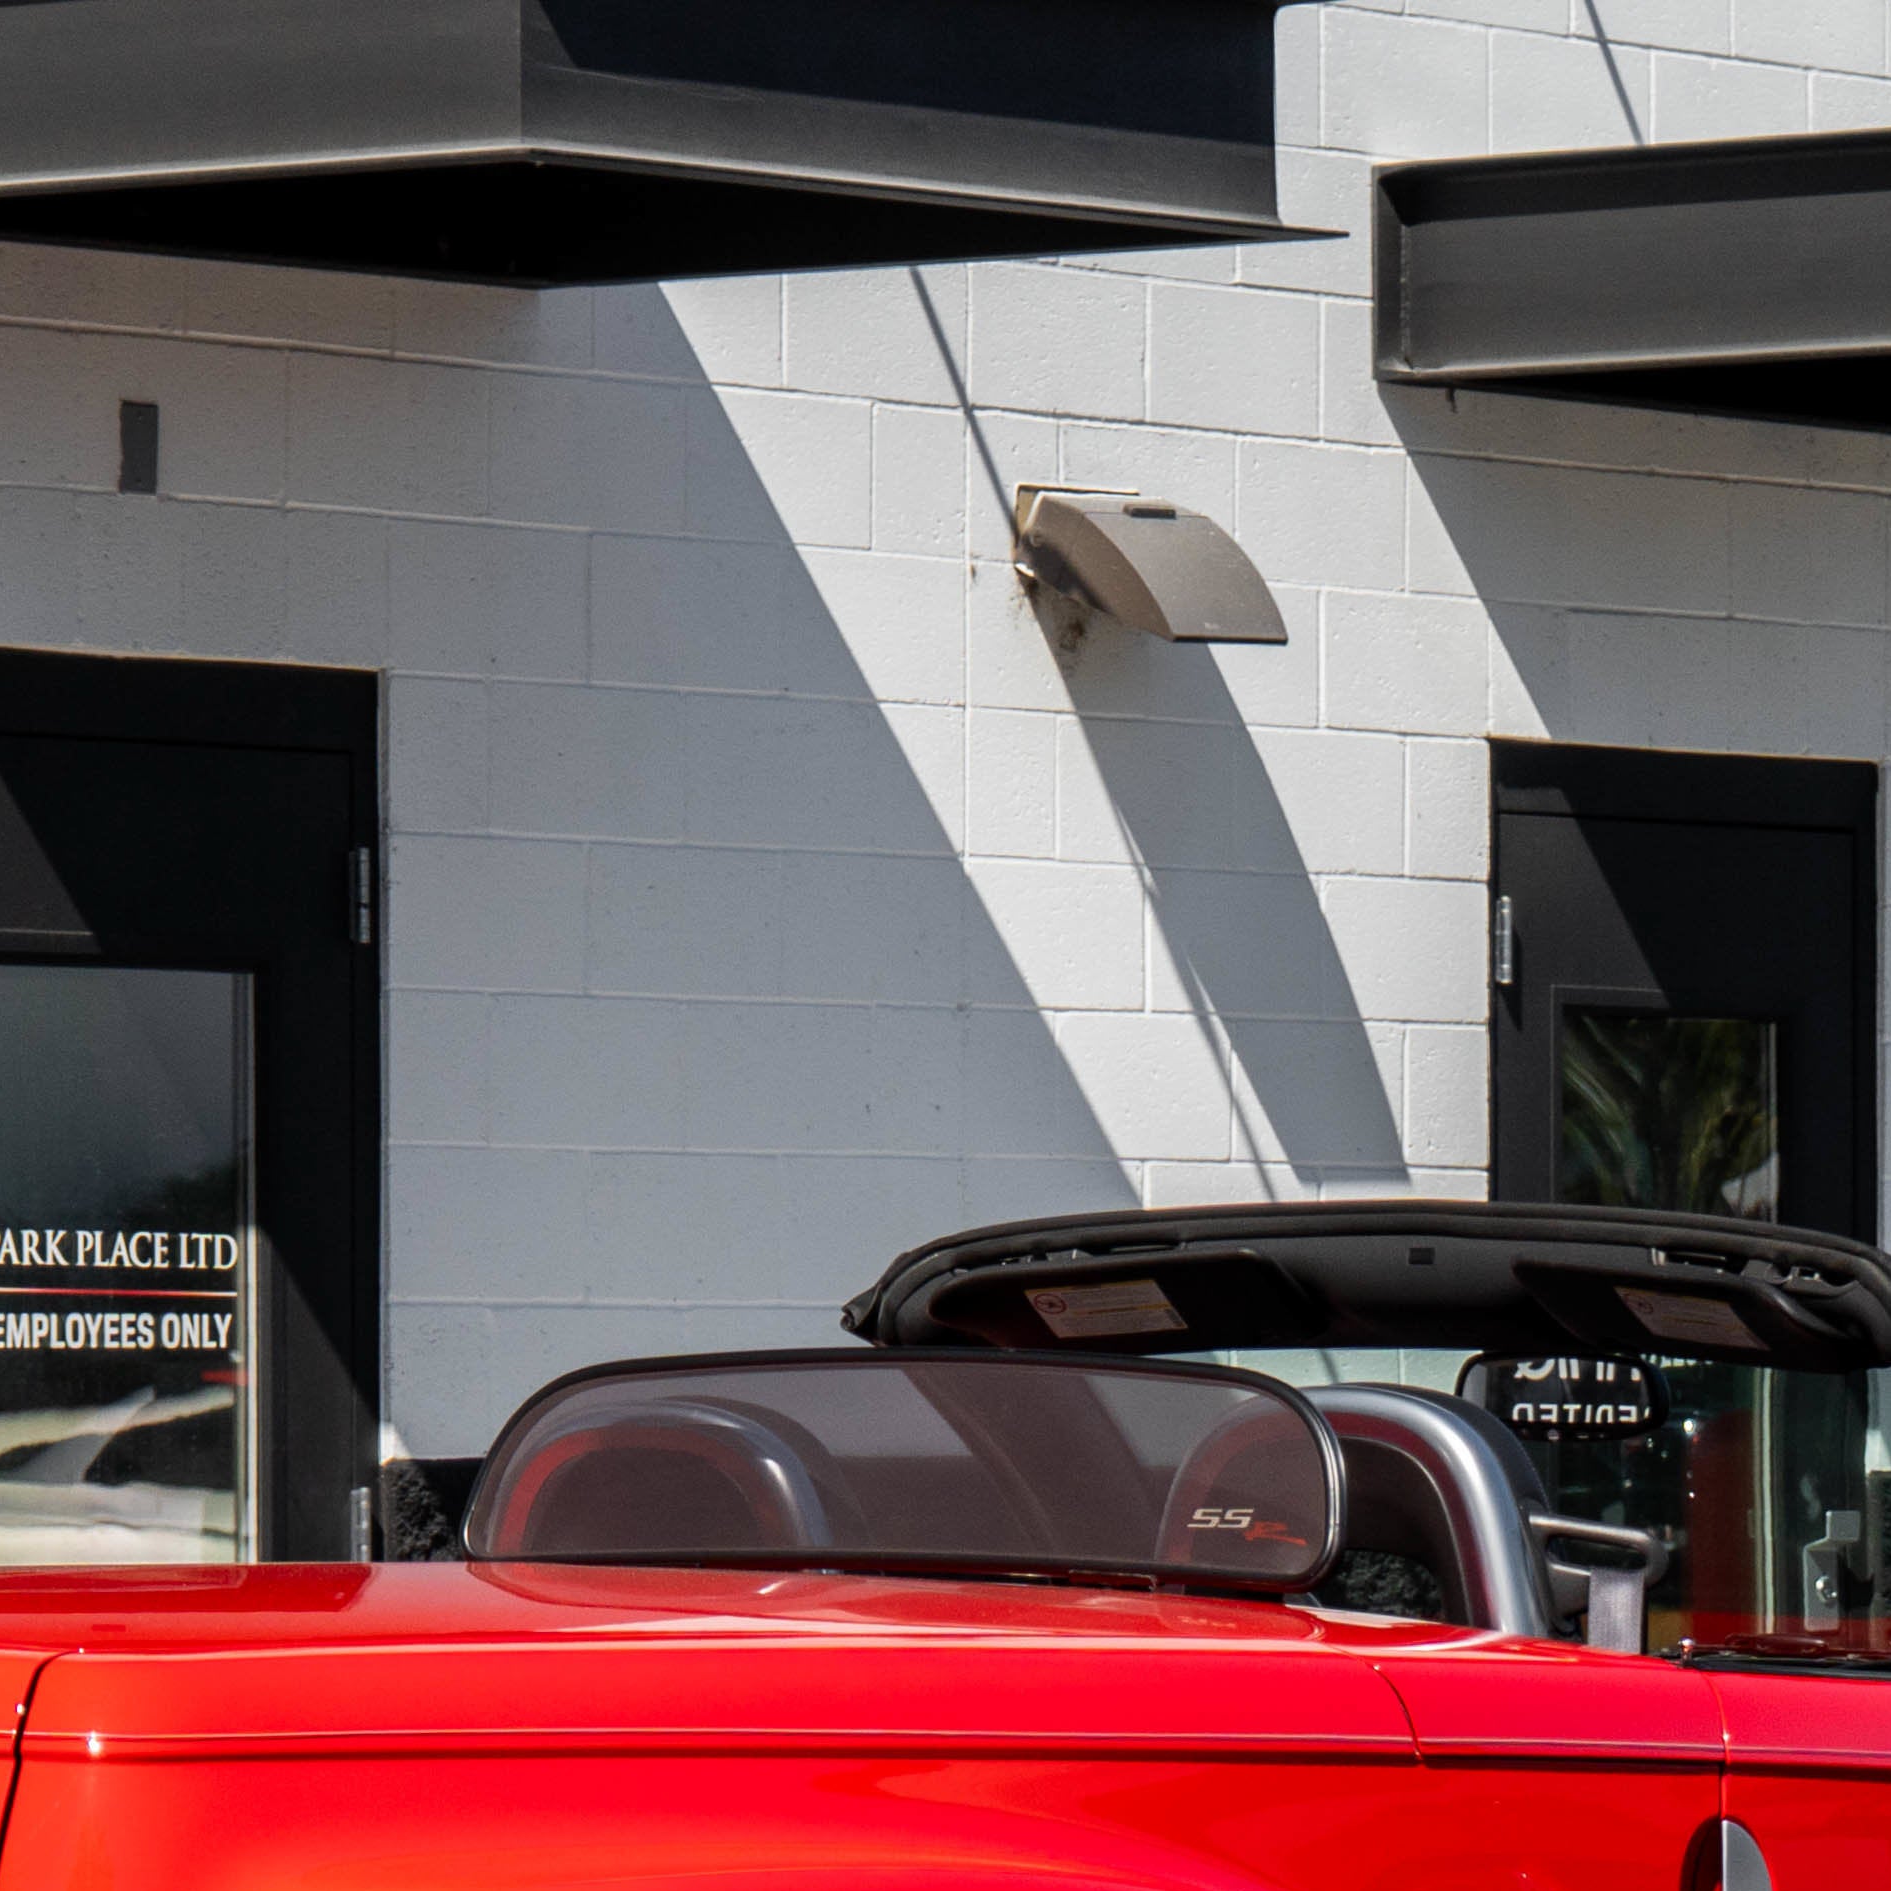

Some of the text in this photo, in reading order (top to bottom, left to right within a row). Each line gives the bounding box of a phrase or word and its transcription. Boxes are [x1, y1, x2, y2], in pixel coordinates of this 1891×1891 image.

[75, 1230, 171, 1269] PLACE
[178, 1232, 238, 1270] LTD
[160, 1312, 232, 1349] ONLY
[1186, 1508, 1308, 1547] SSR
